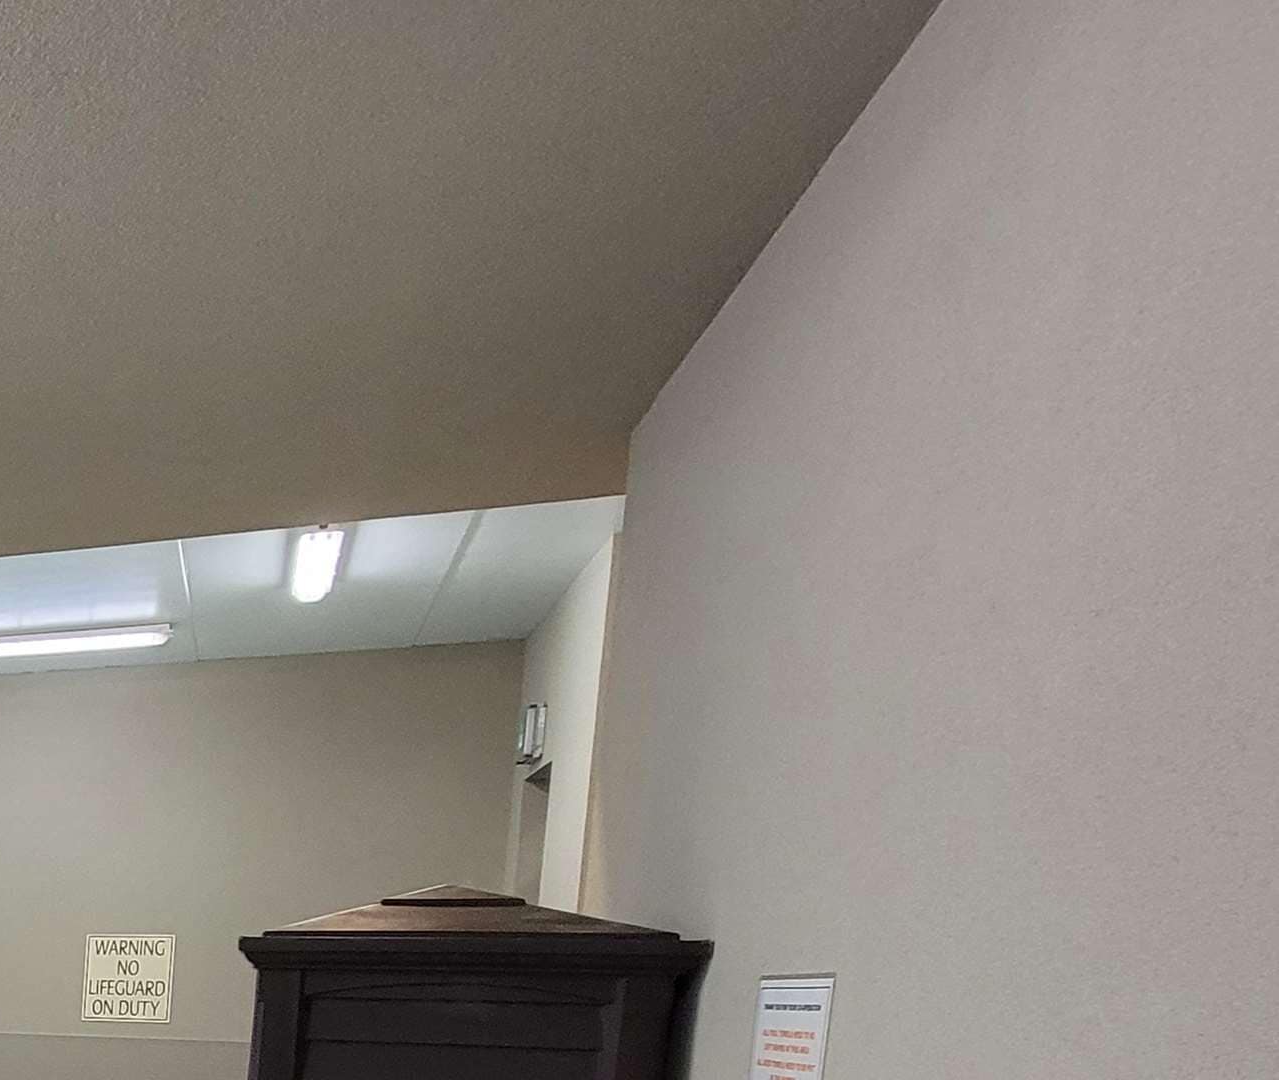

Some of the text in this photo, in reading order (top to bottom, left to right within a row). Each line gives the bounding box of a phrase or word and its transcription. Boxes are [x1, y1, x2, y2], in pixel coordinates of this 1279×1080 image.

[95, 940, 166, 956] WARNING
[116, 960, 140, 976] NO
[88, 979, 166, 997] LIFEGUARD
[92, 999, 160, 1016] ON DUTY
